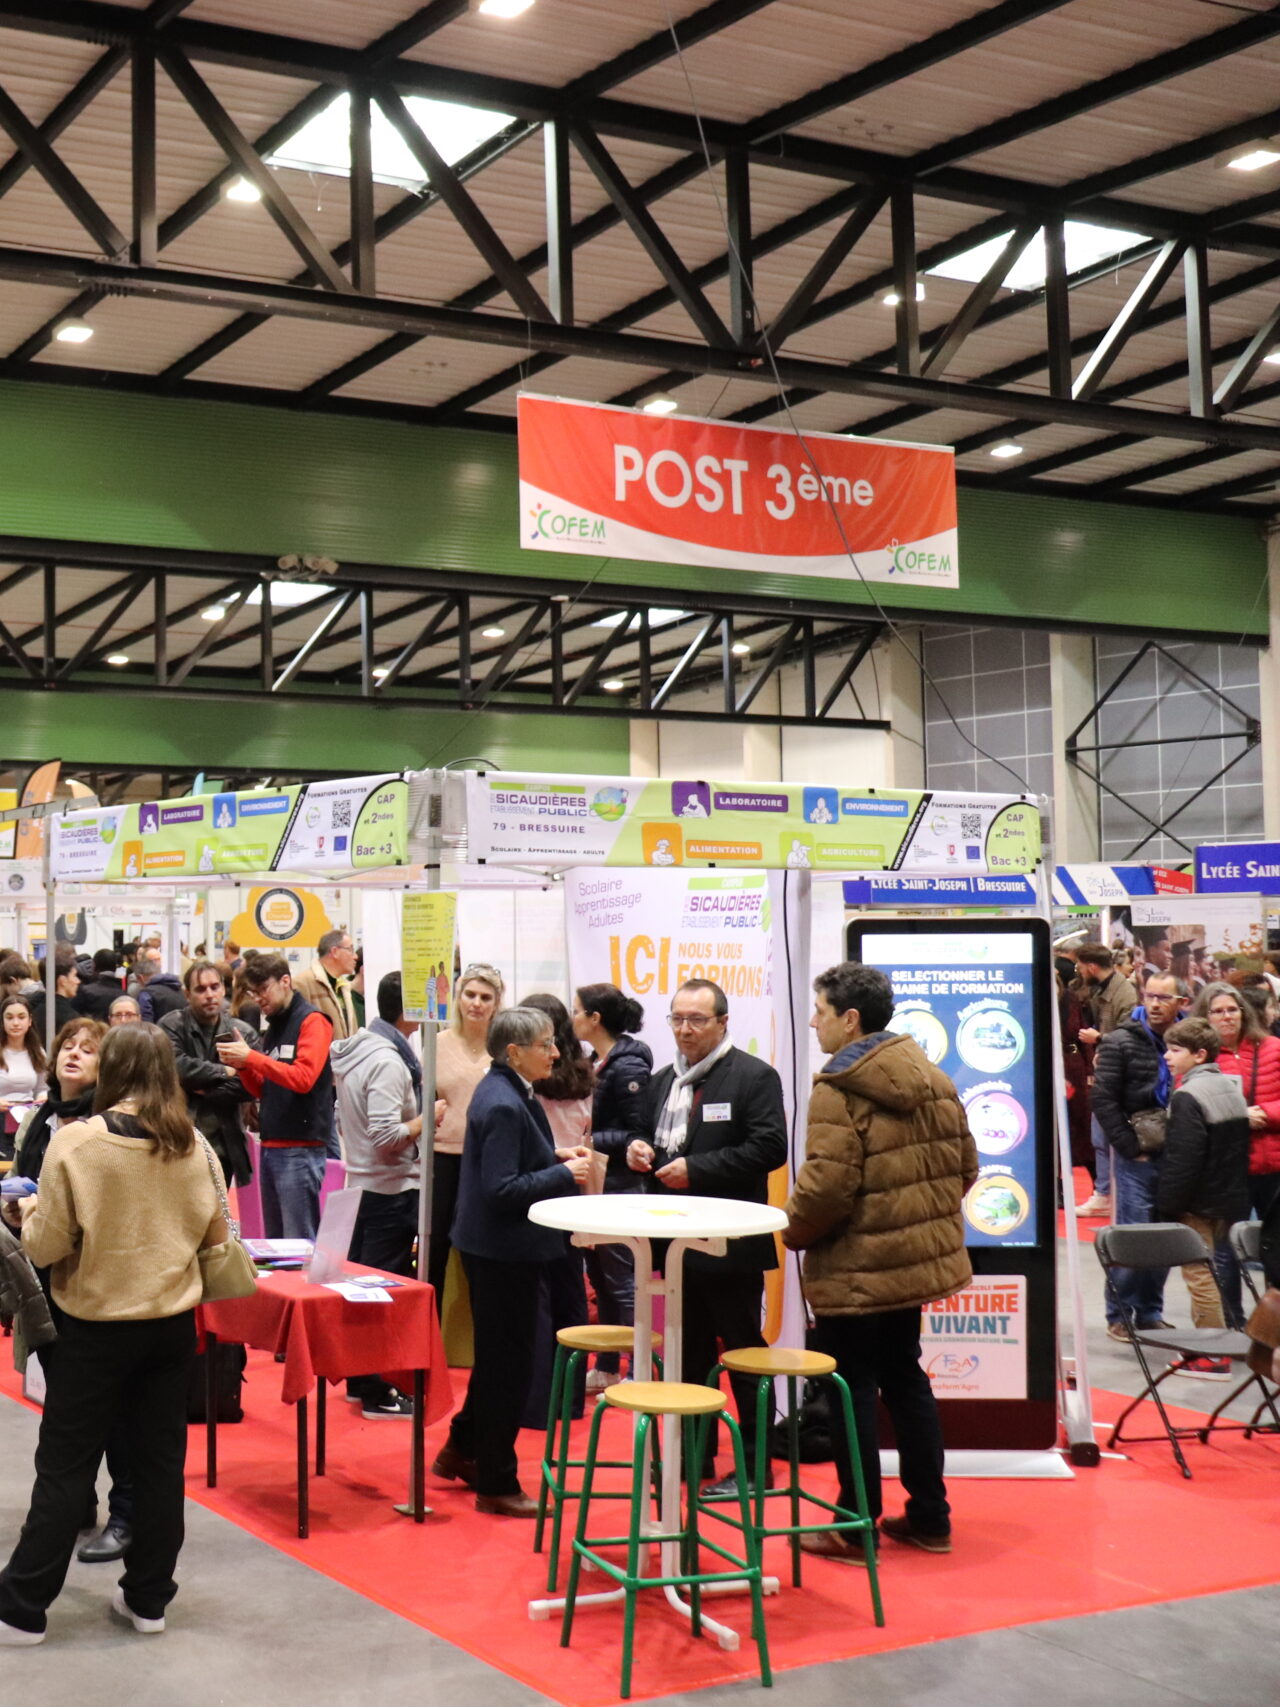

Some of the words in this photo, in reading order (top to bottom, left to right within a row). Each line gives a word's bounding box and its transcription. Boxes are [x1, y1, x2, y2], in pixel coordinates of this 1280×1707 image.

[613, 444, 749, 516] POST
[765, 463, 874, 521] 3ème
[376, 794, 395, 804] CAP
[496, 793, 587, 807] SICAUDIÈRES
[719, 797, 784, 809] LABORATOIRE
[538, 807, 588, 817] PUBLIC
[845, 802, 905, 814] ENVIRONNEMENT
[1006, 813, 1024, 822] CAP
[520, 823, 586, 834] BRESSUIRE
[356, 845, 375, 856] Bac
[379, 843, 393, 854] +3
[688, 843, 759, 856] ALIMENTATION
[991, 855, 1011, 866] Bac
[1014, 856, 1027, 867] +3
[1201, 861, 1240, 879] LYCÉE
[579, 879, 623, 897] Scolaire
[977, 877, 1027, 892] BRESSUIRE
[589, 911, 624, 929] Adultes
[724, 915, 758, 928] PUBLIC
[677, 942, 713, 959] NOUS
[716, 943, 744, 959] VOUS
[608, 934, 672, 995] ICI
[988, 970, 1004, 981] LE
[891, 983, 929, 995] MAINE
[931, 983, 949, 995] DE
[951, 983, 1024, 995] FORMATION
[929, 1315, 1011, 1335] VIVANT
